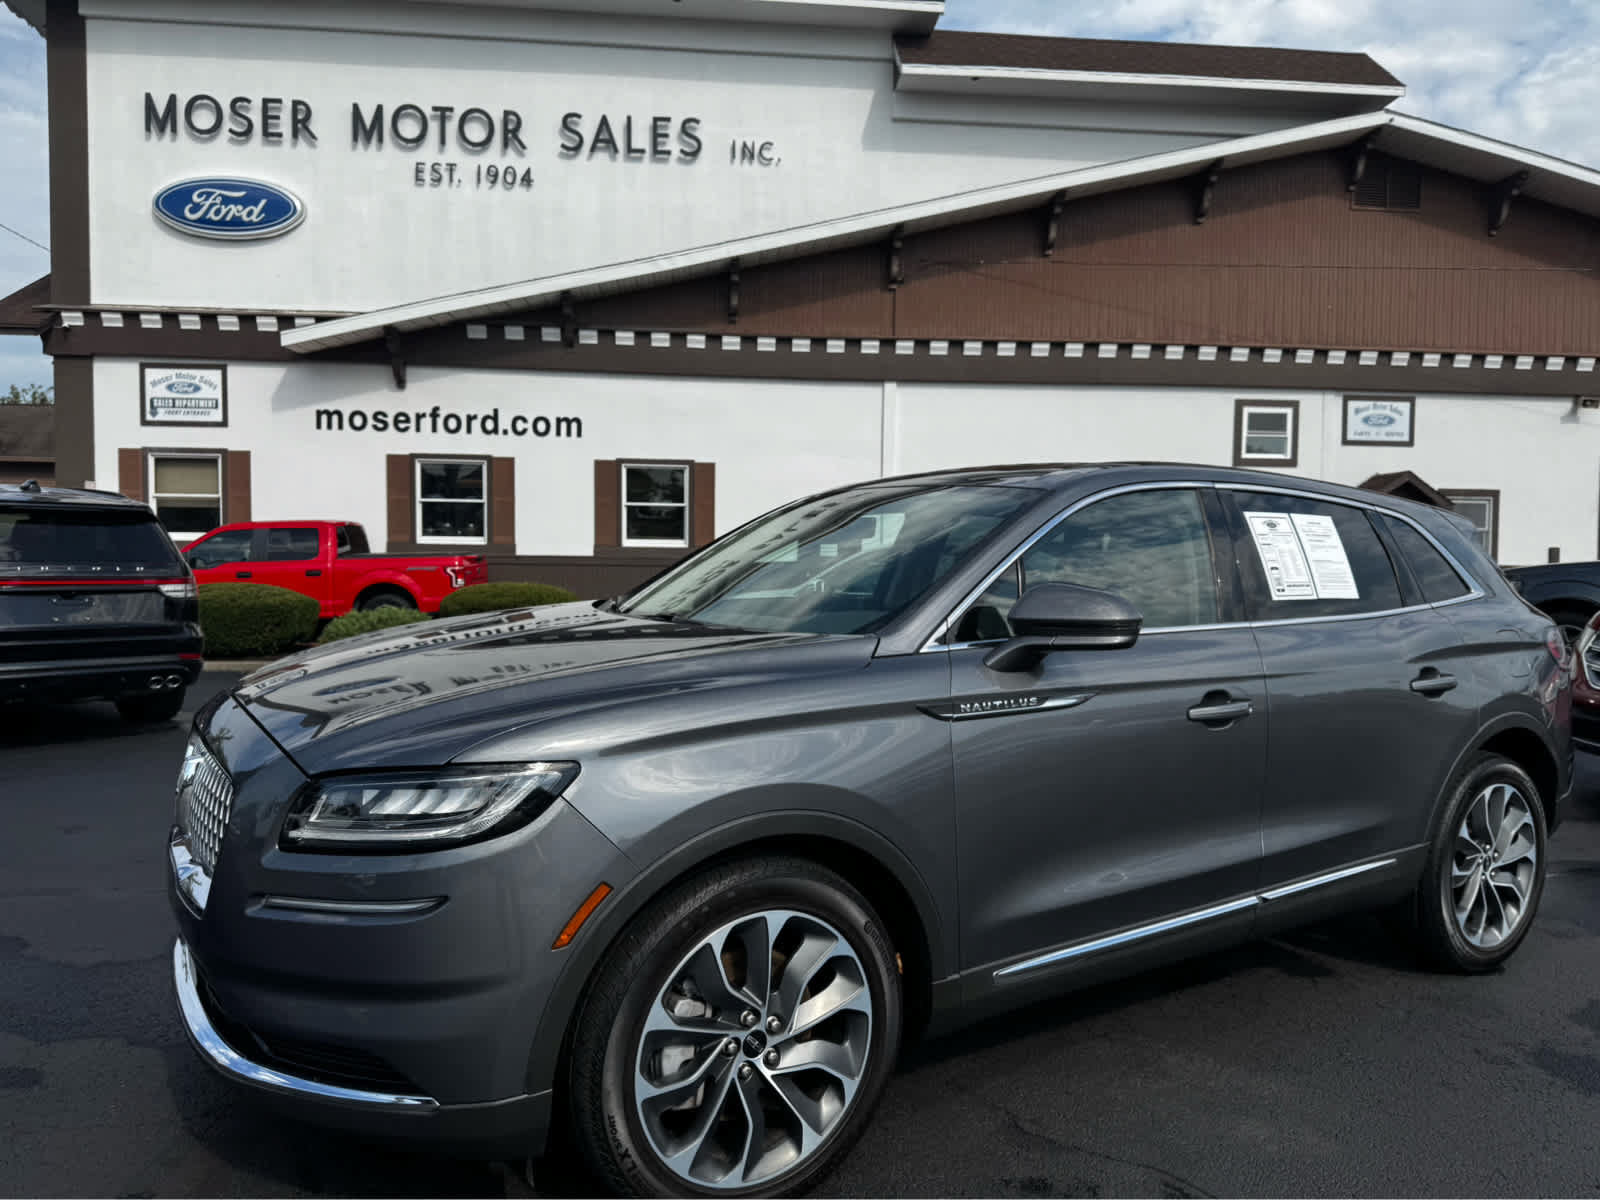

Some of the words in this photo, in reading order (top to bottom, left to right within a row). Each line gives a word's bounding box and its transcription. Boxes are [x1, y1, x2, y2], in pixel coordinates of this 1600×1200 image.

[144, 91, 318, 143] MOSER
[352, 102, 527, 150] MOTOR
[560, 112, 703, 157] SALES
[414, 162, 462, 186] EST.
[476, 164, 534, 189] 1904
[184, 188, 267, 223] Ford
[315, 406, 583, 438] moserford.com
[960, 697, 1039, 713] NAUTILUS
